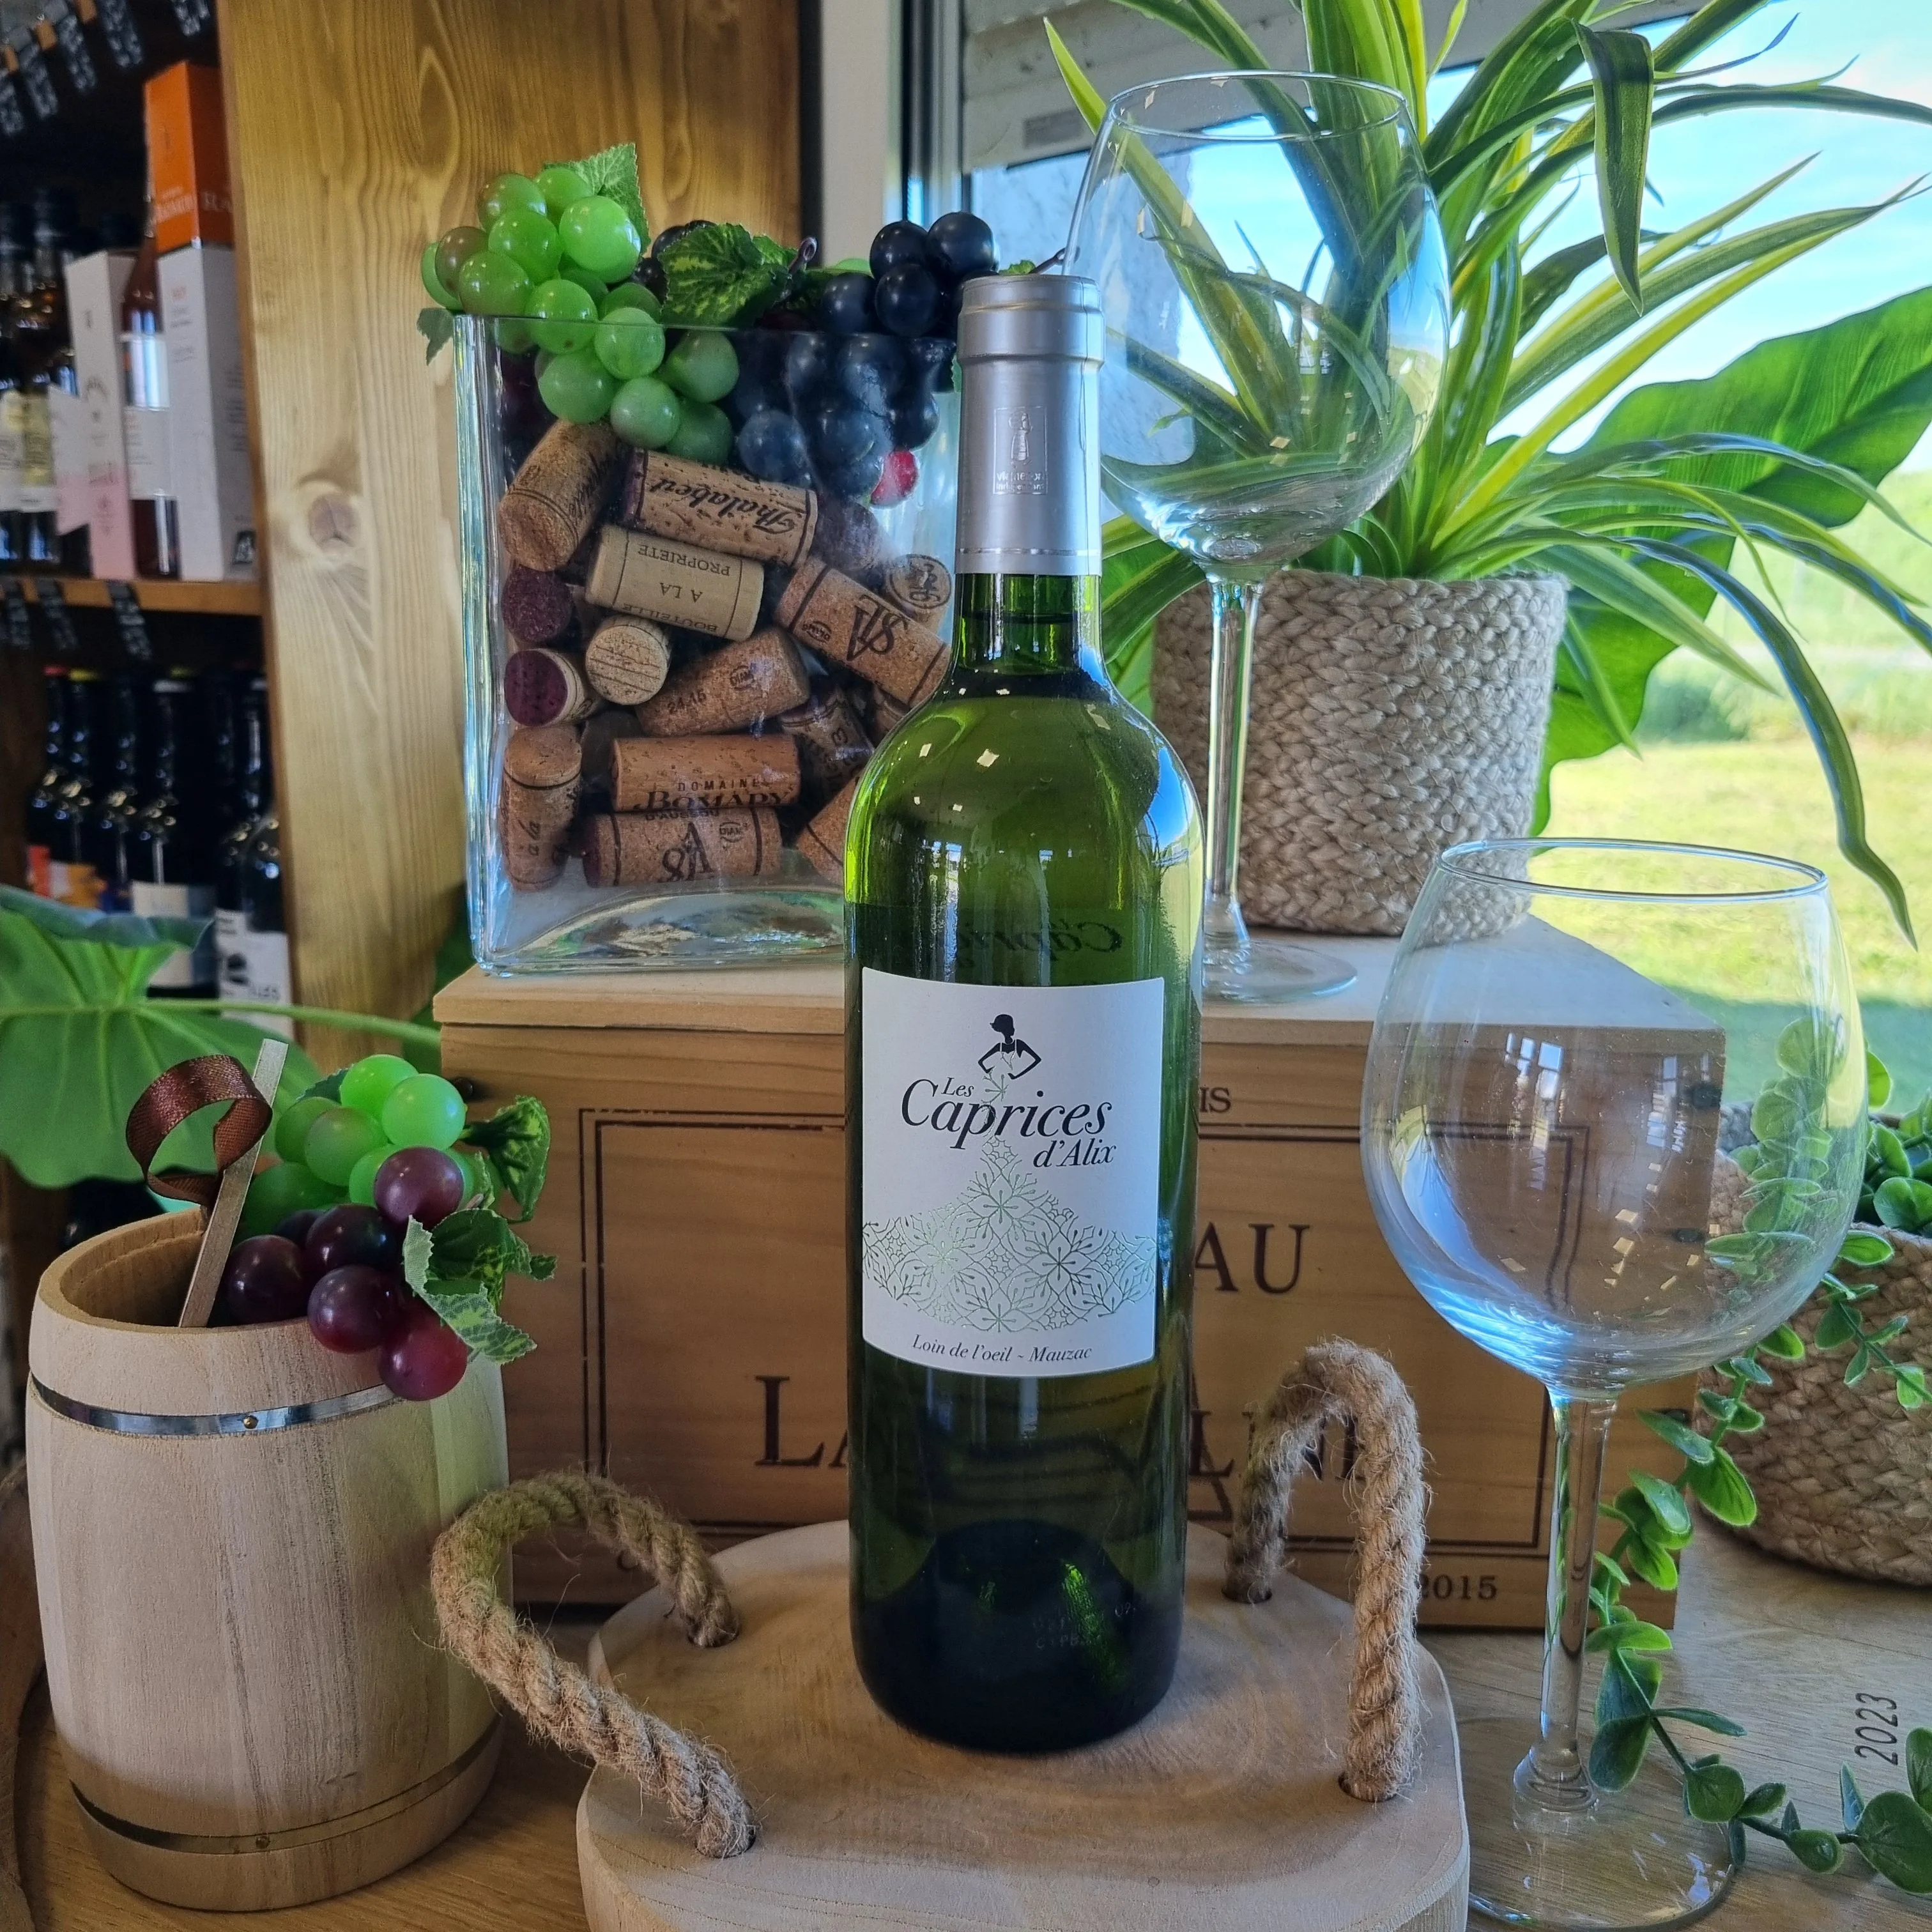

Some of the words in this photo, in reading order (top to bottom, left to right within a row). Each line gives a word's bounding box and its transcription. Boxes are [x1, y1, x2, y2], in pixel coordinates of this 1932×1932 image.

[638, 544, 731, 576] PROPRIETE
[659, 582, 682, 600] LA
[690, 589, 703, 602] A
[678, 778, 760, 792] DOMAINE
[940, 1077, 974, 1098] Les
[901, 1078, 1112, 1149] Caprices
[1032, 1137, 1117, 1168] d'Alix
[912, 1333, 945, 1354] Loin
[949, 1342, 969, 1358] de
[972, 1344, 1012, 1361] l'oeil
[1027, 1346, 1092, 1361] Mauzac
[1855, 1692, 1898, 1766] 2023
